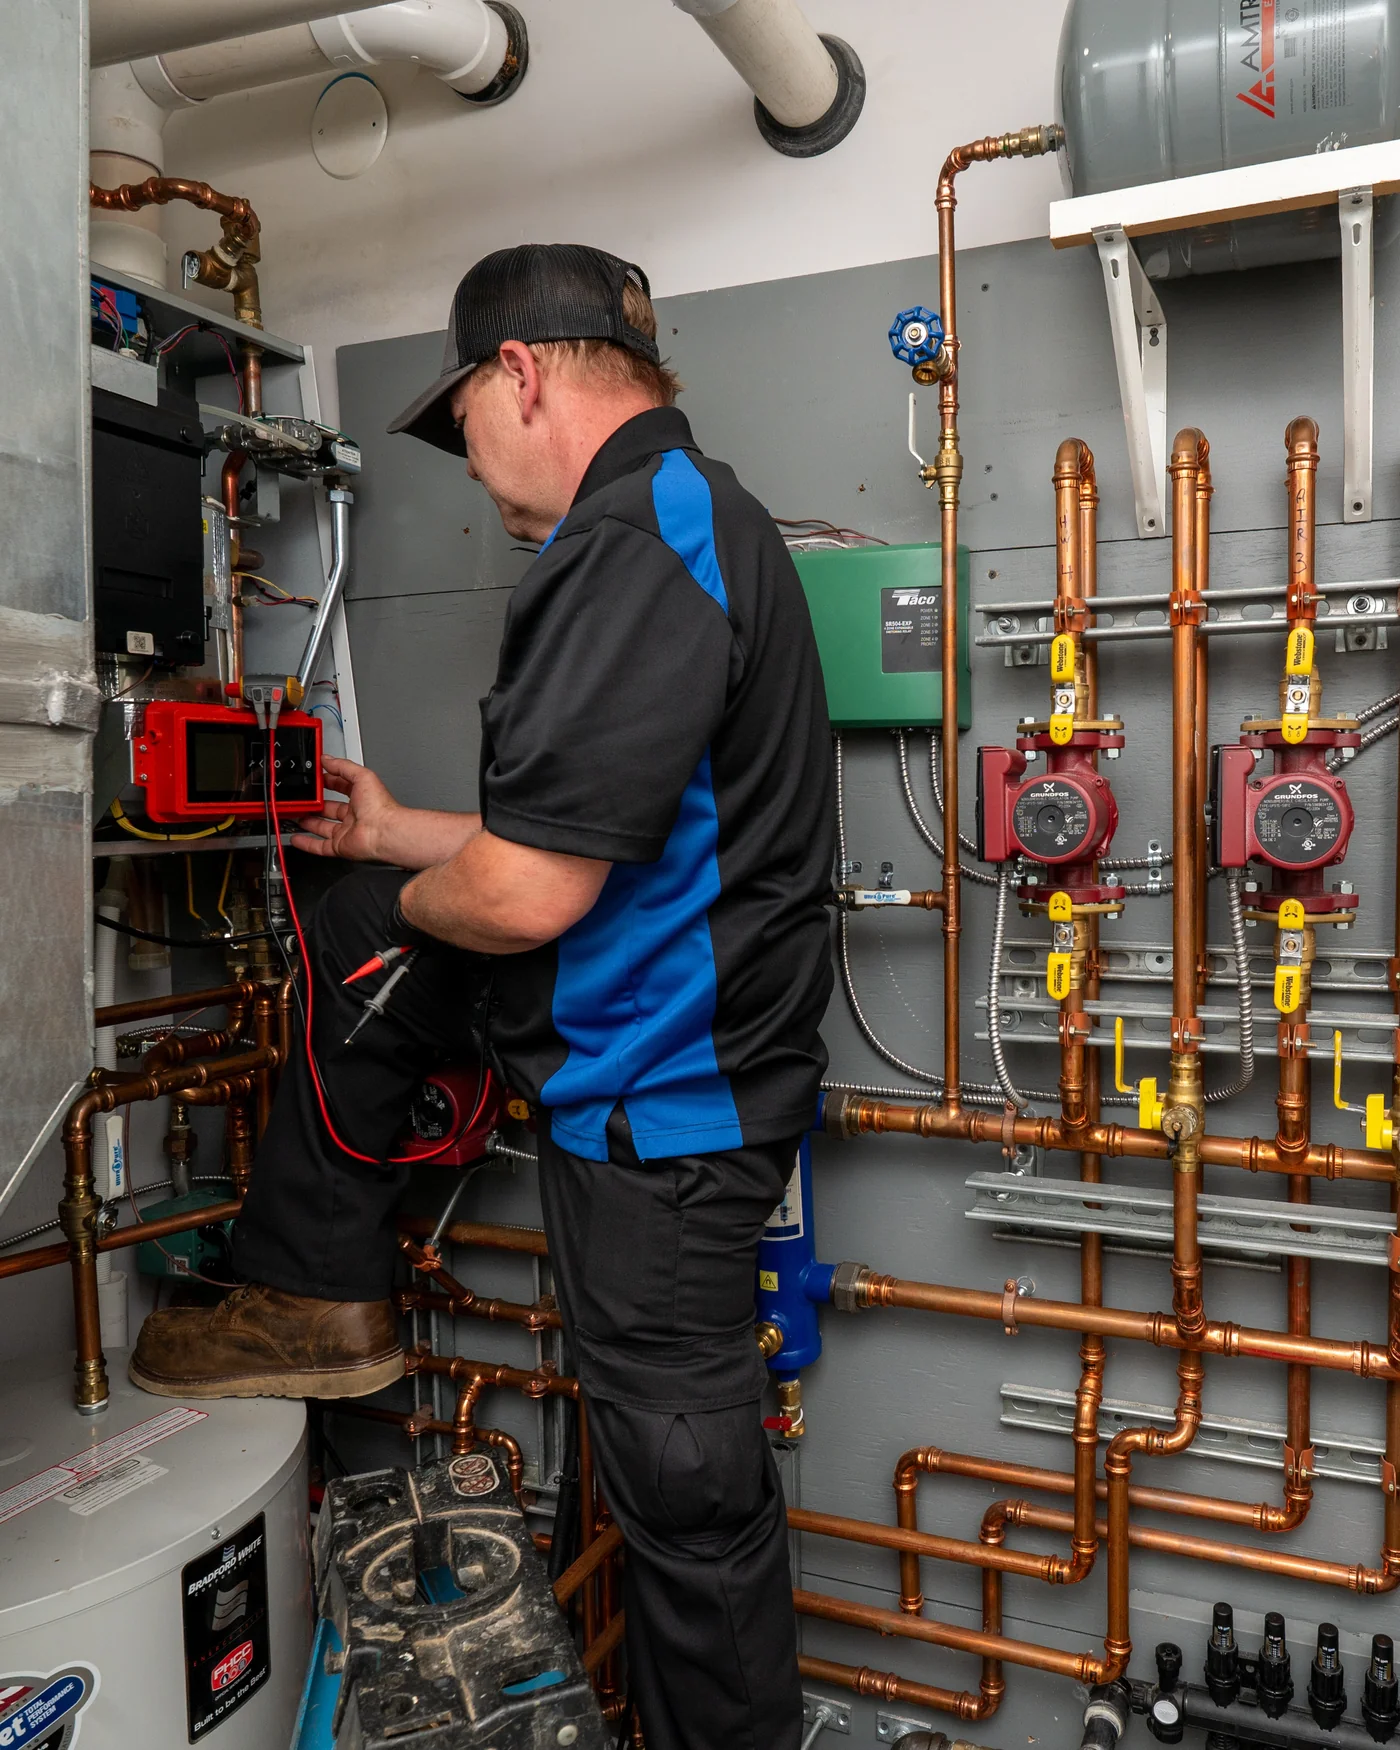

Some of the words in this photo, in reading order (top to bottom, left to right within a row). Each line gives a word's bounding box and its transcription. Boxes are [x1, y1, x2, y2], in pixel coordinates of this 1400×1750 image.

[892, 589, 936, 606] Taco
[1294, 634, 1303, 666] Webstone
[1285, 976, 1294, 1007] Webstone
[188, 1556, 237, 1596] BRADFORD
[238, 1537, 262, 1562] WHITE
[214, 1643, 252, 1681] PHCC
[2, 1698, 28, 1717] WITH
[24, 1699, 45, 1716] TOTAL
[27, 1682, 75, 1723] PERFORMANCE
[194, 1712, 214, 1732] Built
[215, 1705, 224, 1716] to
[225, 1696, 236, 1709] be
[237, 1684, 250, 1698] the
[250, 1668, 266, 1686] Best
[30, 1705, 57, 1729] SYSTEM
